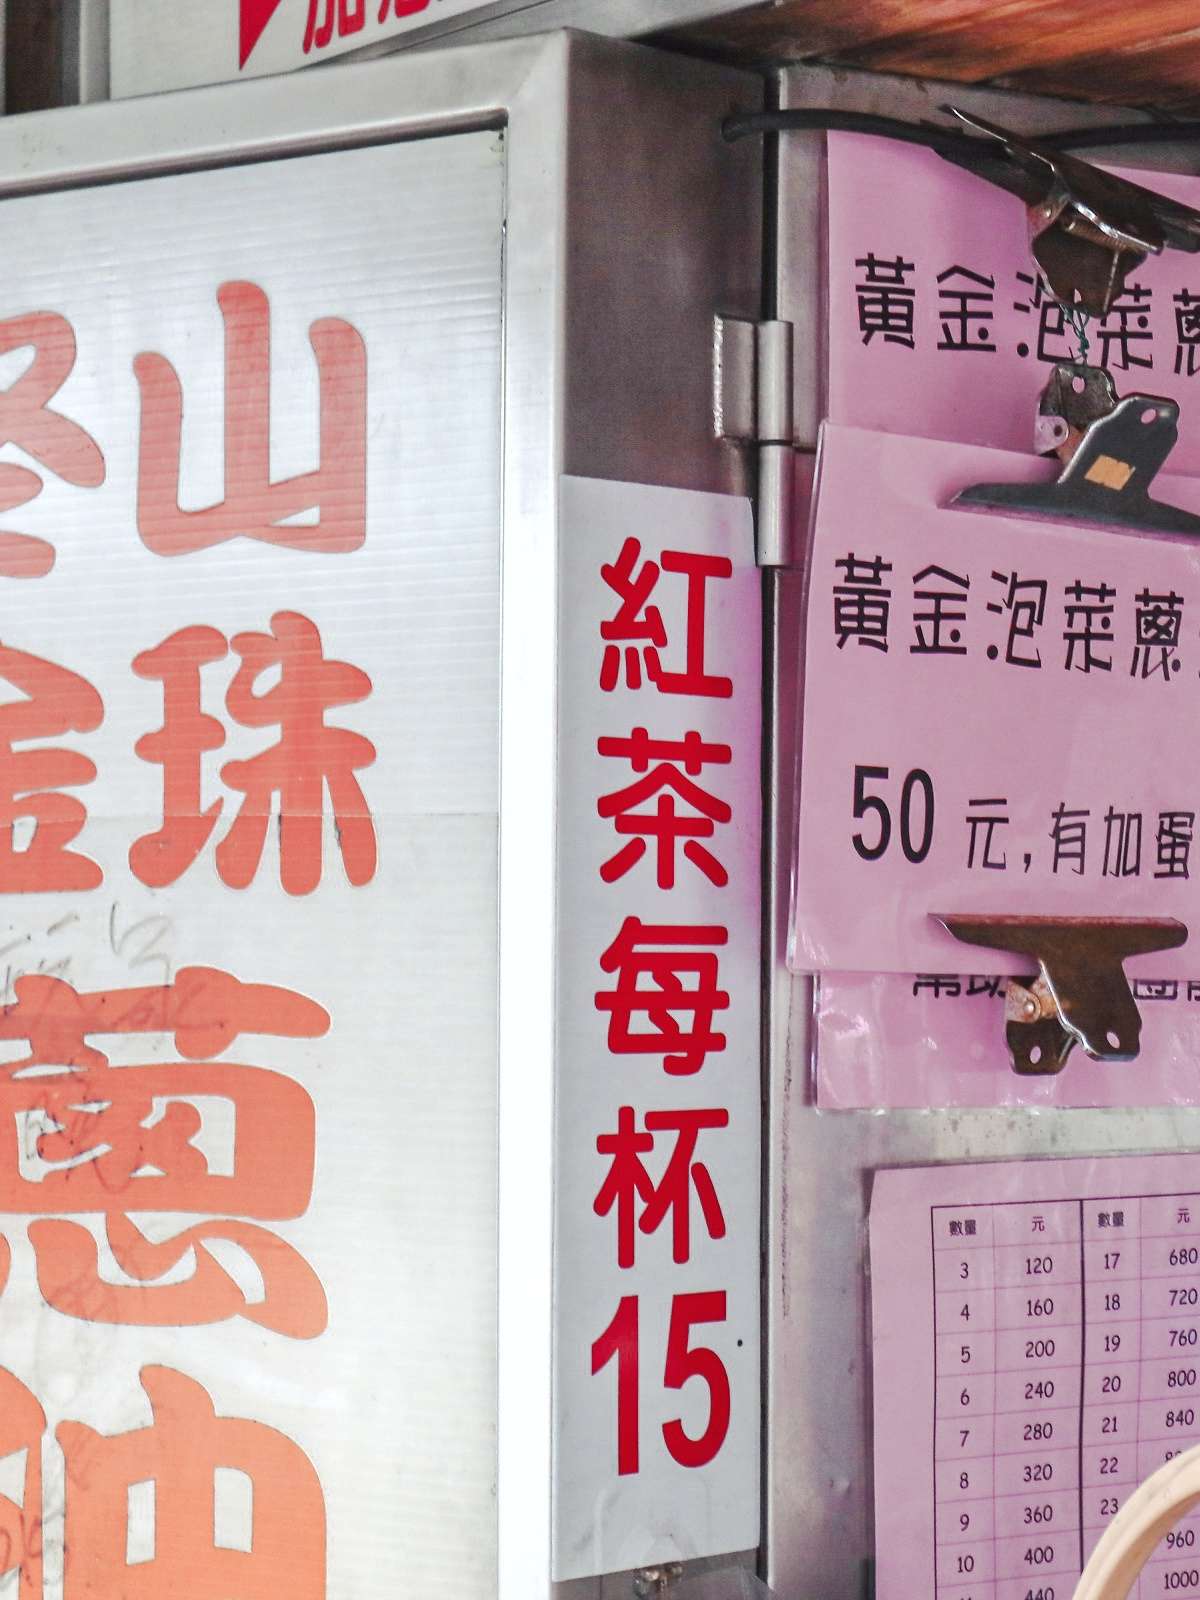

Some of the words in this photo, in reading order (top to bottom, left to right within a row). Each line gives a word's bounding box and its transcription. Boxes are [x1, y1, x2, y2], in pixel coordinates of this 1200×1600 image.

[1031, 1215, 1046, 1233] 元
[1176, 1207, 1191, 1225] 元
[959, 1261, 969, 1280] 3
[1025, 1255, 1053, 1276] 120
[1103, 1251, 1121, 1271] 17
[1168, 1247, 1199, 1267] 680
[959, 1303, 971, 1322] 4
[1026, 1297, 1055, 1318] 160
[1104, 1292, 1121, 1313] 18
[1168, 1287, 1199, 1307] 720
[960, 1345, 971, 1364] 5
[1025, 1338, 1056, 1359] 200
[1104, 1333, 1121, 1353] 19
[1168, 1327, 1198, 1348] 760
[959, 1387, 971, 1407] 6
[1024, 1380, 1055, 1401] 240
[1101, 1374, 1122, 1394] 20
[1167, 1368, 1197, 1389] 800
[959, 1429, 971, 1448] 7
[1023, 1421, 1054, 1442] 280
[1101, 1415, 1118, 1435] 21
[1165, 1408, 1195, 1428] 840
[959, 1471, 970, 1490] 8
[1022, 1462, 1054, 1483] 320
[1099, 1456, 1119, 1475] 22
[959, 1513, 970, 1532] 9
[1023, 1503, 1054, 1525] 360
[1100, 1497, 1119, 1516] 23
[957, 1554, 975, 1574] 10
[1023, 1545, 1055, 1566] 400
[1166, 1529, 1196, 1550] 960
[1163, 1569, 1200, 1591] 1000
